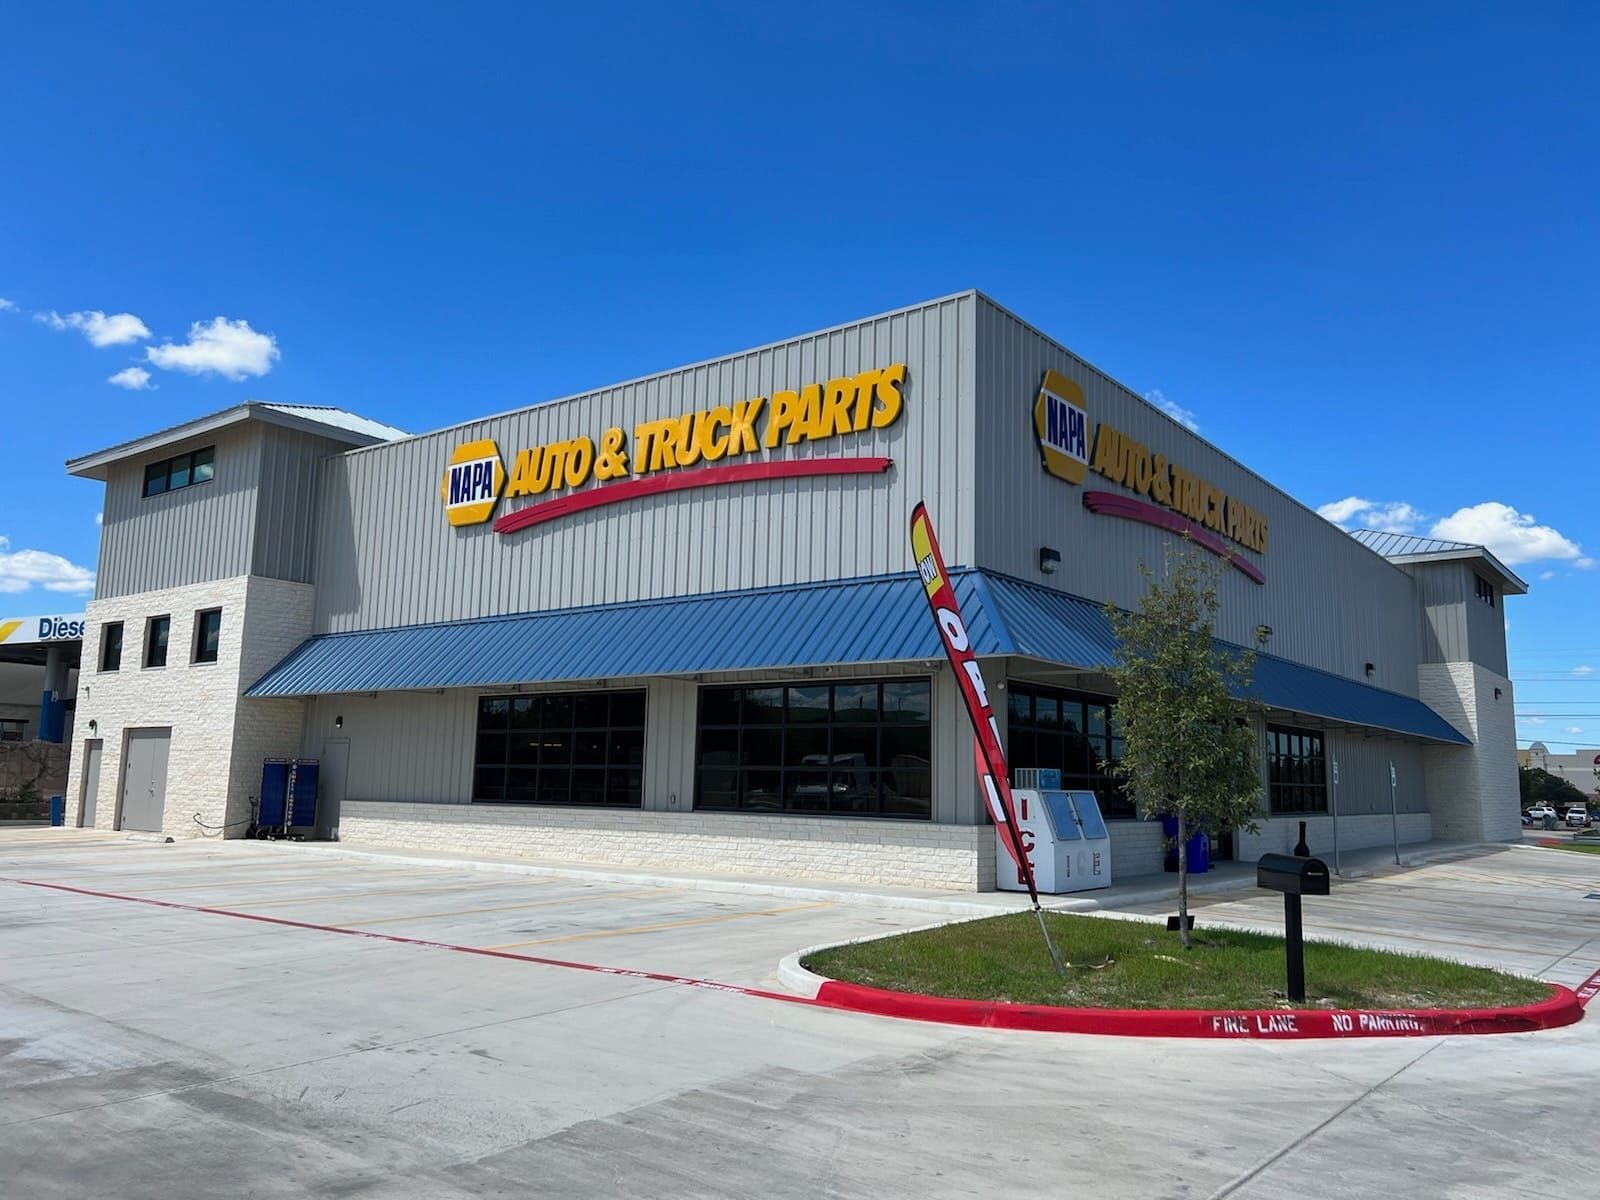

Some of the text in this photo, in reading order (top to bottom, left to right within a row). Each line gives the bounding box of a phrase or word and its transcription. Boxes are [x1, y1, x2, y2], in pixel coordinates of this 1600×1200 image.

[504, 364, 907, 499] AUTO & TRUCK PARTS
[1047, 395, 1086, 460] NAPA
[450, 461, 493, 505] NAPA
[1090, 423, 1269, 554] AUTO & TRUCK PARTS
[1256, 1014, 1299, 1033] LANE
[1331, 1014, 1353, 1032] NO
